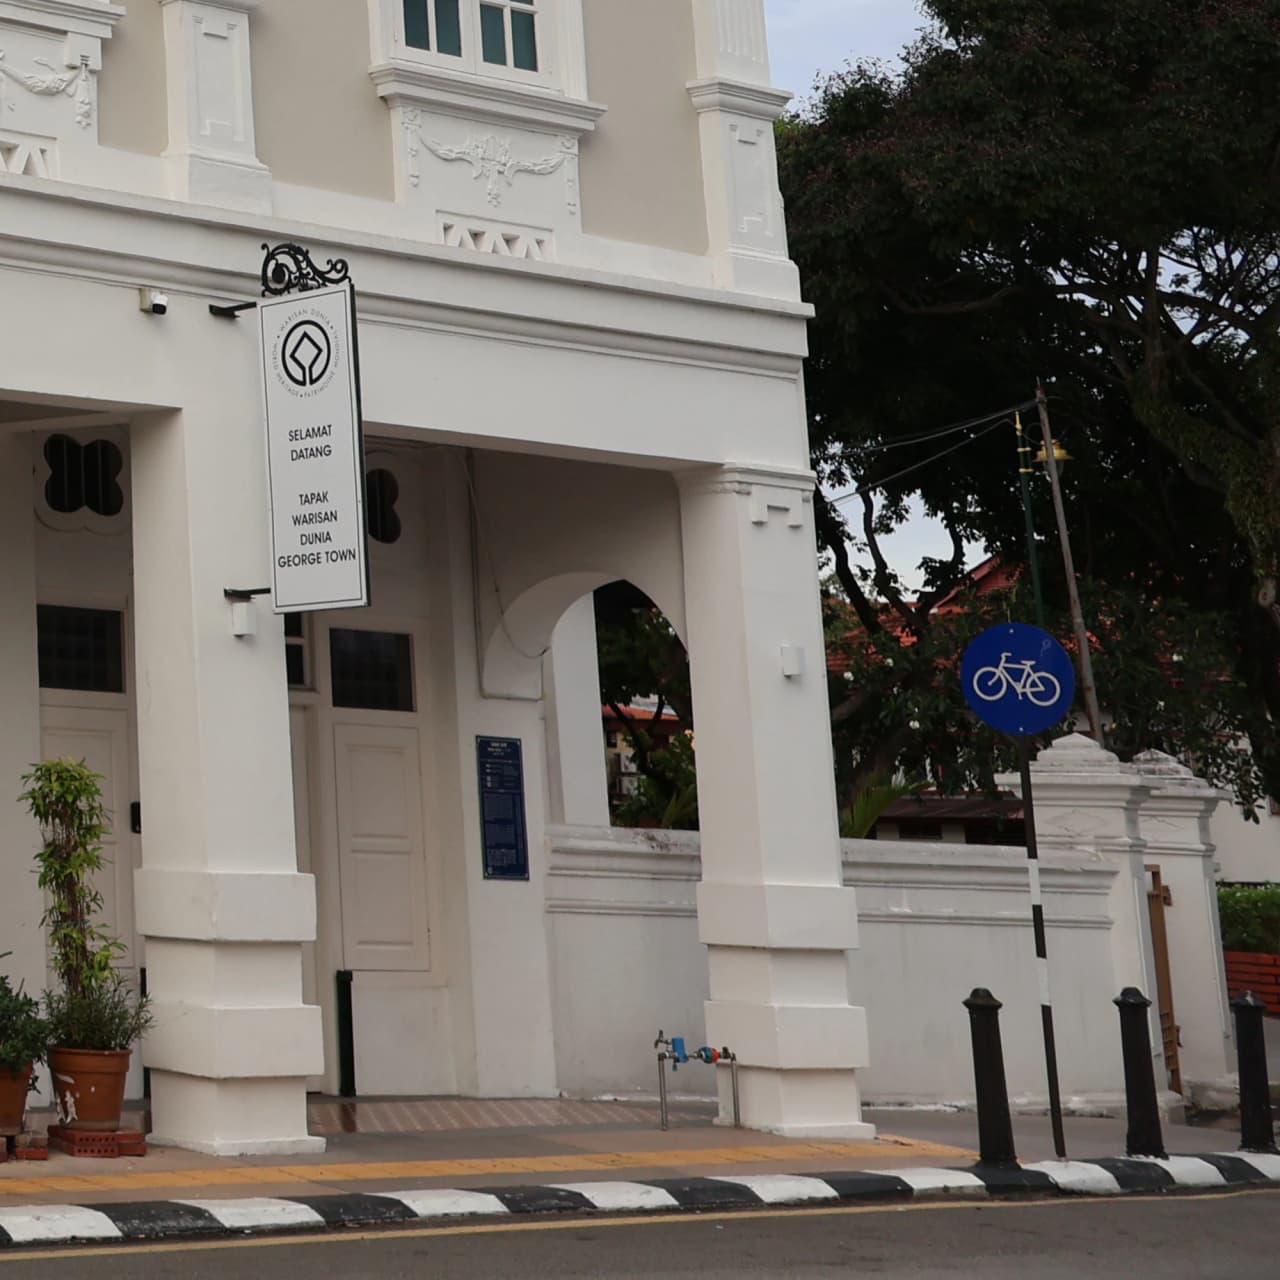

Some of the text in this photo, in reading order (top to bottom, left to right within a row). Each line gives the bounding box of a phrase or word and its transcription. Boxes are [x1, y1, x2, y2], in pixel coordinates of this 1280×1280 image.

[288, 424, 332, 442] SELAMAT
[290, 444, 332, 461] DATANG
[299, 490, 329, 506] TAPAK
[292, 510, 338, 527] WARISAN
[300, 531, 332, 546] DUNIA
[278, 549, 356, 568] GEORGE TOWN
